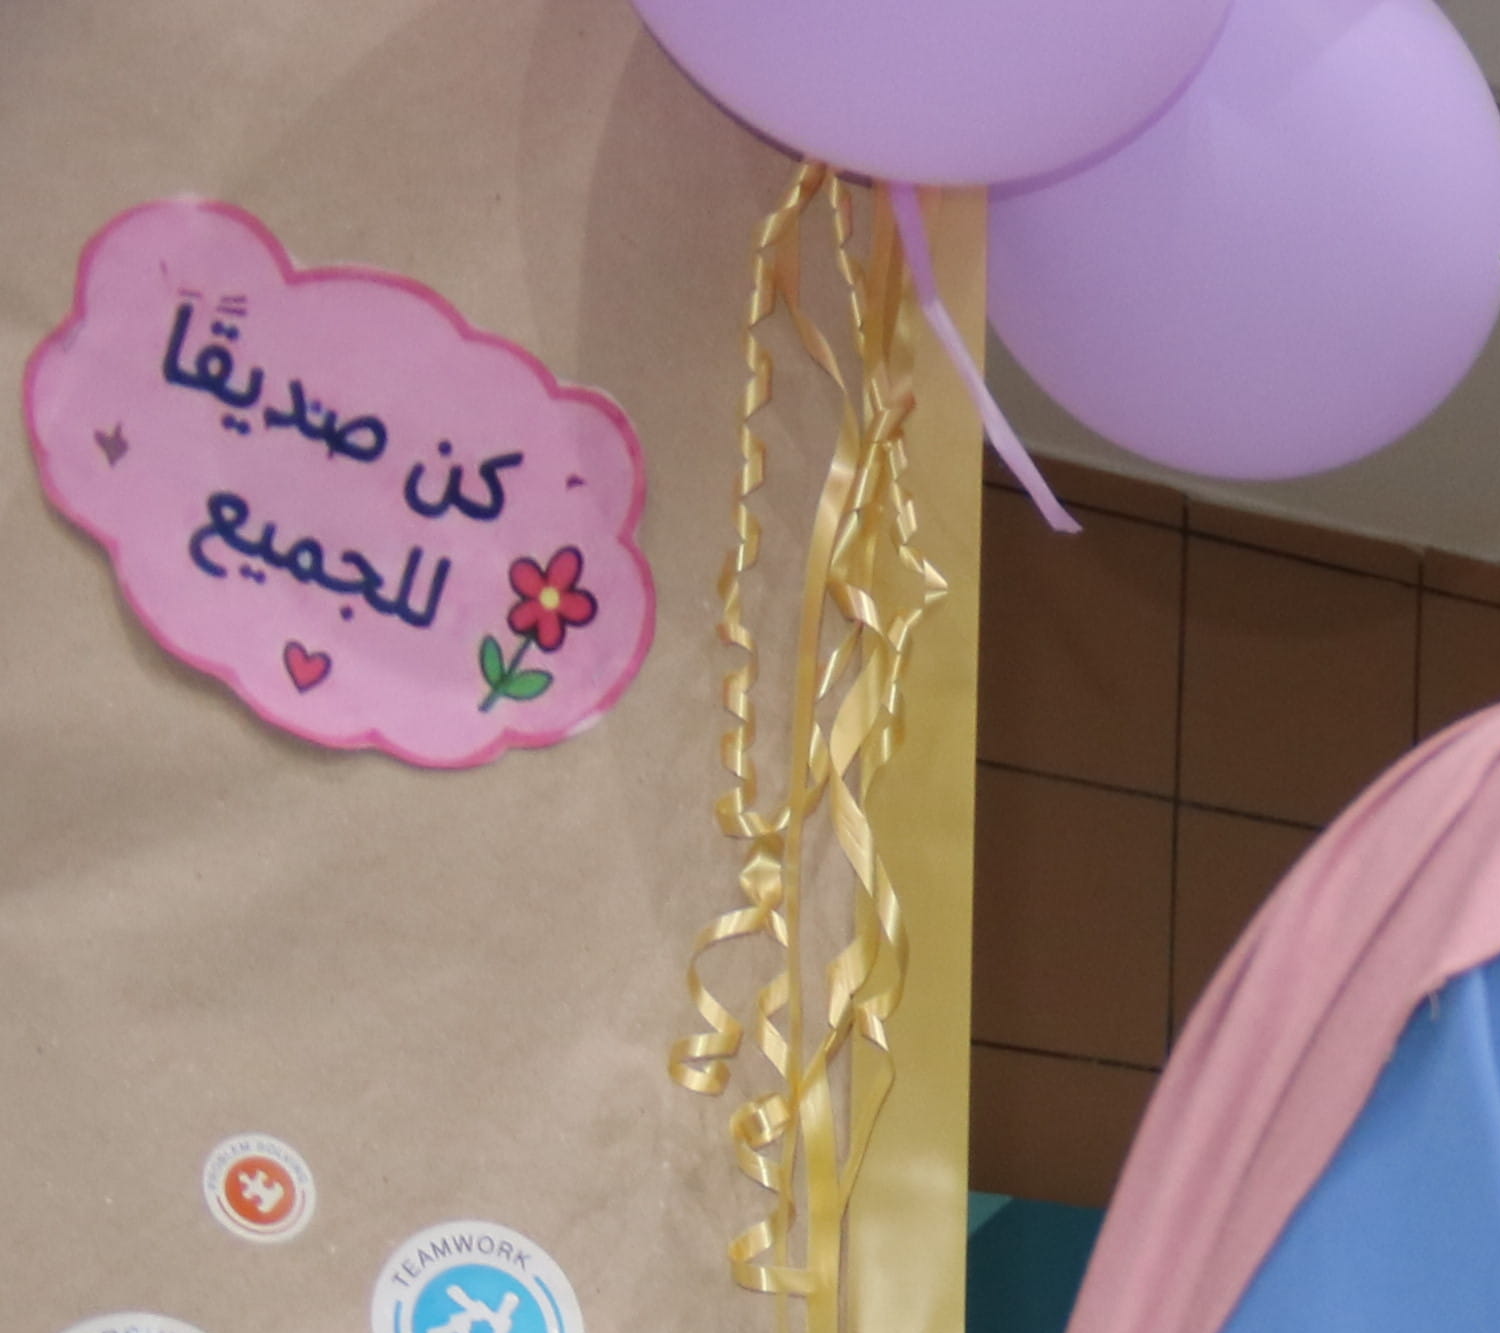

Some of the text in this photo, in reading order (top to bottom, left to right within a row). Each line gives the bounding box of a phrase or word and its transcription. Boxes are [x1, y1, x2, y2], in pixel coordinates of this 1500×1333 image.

[403, 440, 524, 521] كن
[189, 492, 452, 628] للجميع
[391, 1234, 532, 1287] TEAMWORK
